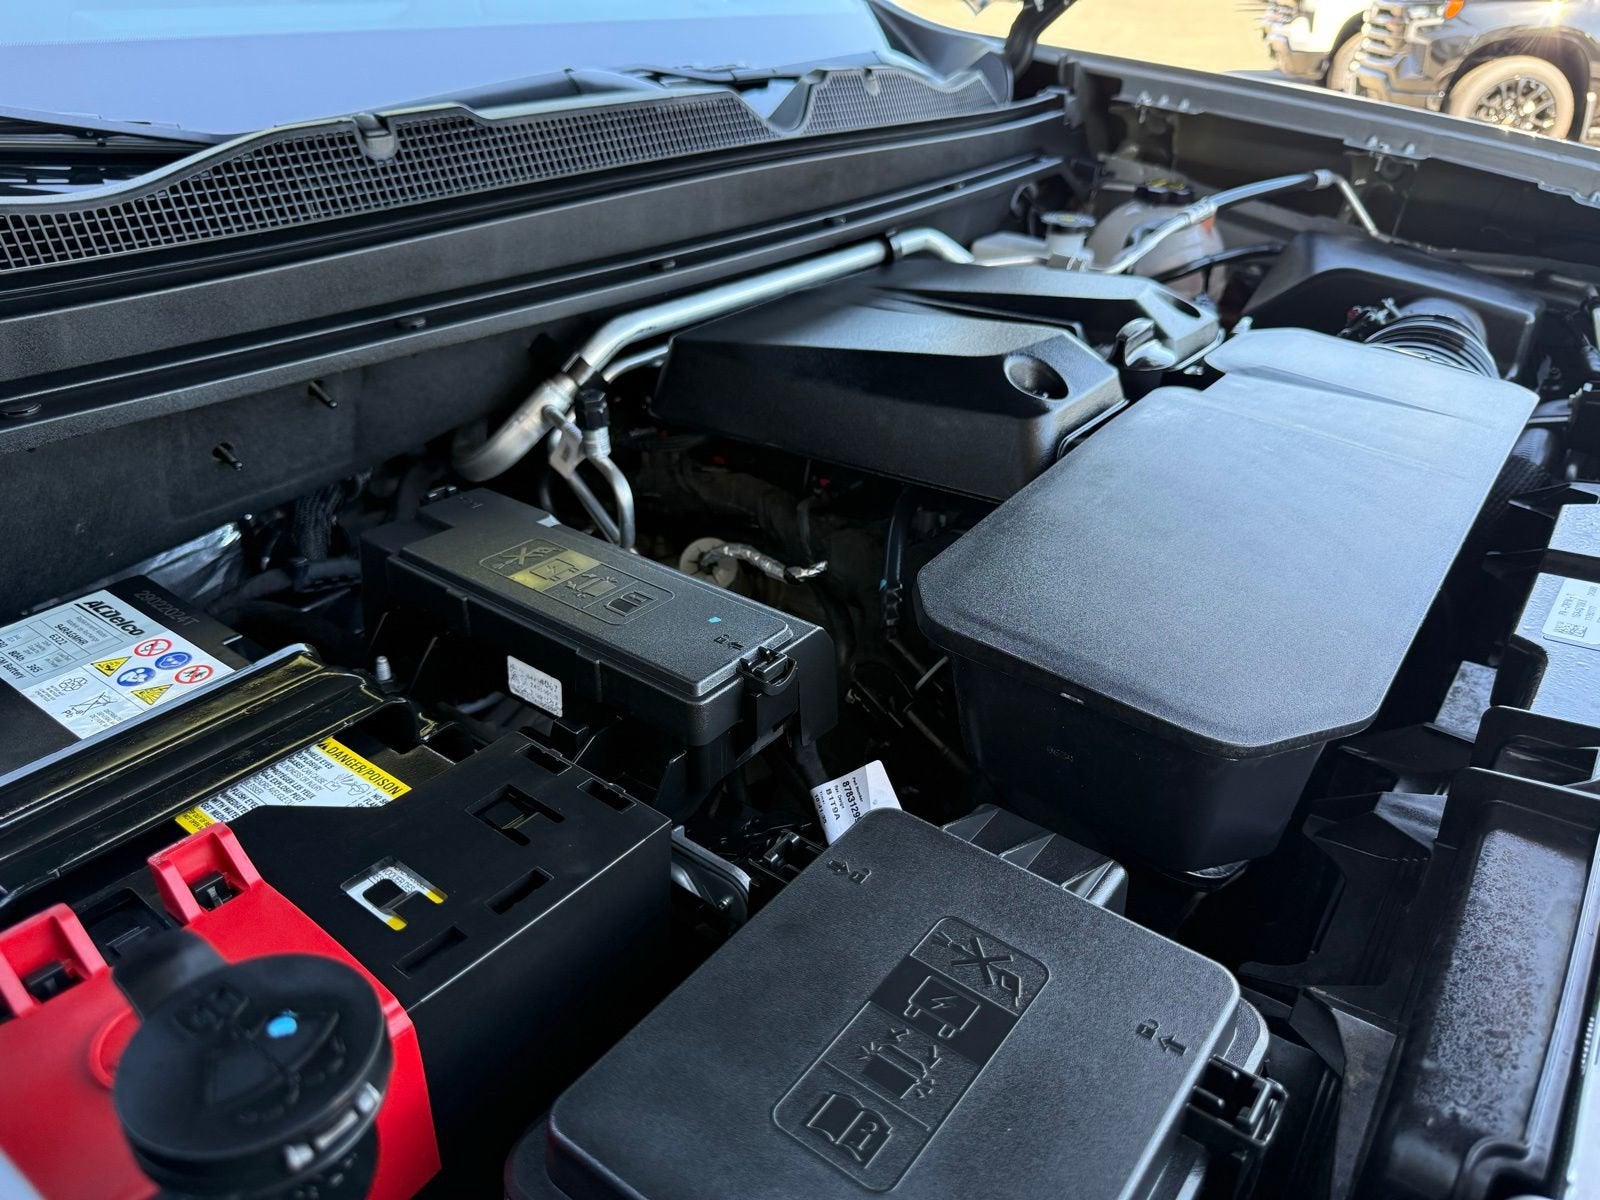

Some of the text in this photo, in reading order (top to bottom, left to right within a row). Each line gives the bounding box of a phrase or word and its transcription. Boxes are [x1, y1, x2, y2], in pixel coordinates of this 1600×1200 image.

[82, 599, 145, 638] ACDelco
[49, 633, 68, 646] 6322
[3, 662, 26, 680] Battery
[288, 757, 305, 768] GASES
[295, 753, 321, 770] EXPLOSIVE
[320, 759, 335, 769] EYES
[326, 745, 403, 796] DANGER/POISON
[230, 788, 248, 800] FLUSH
[291, 792, 306, 802] PEUT
[301, 788, 316, 798] YEUX
